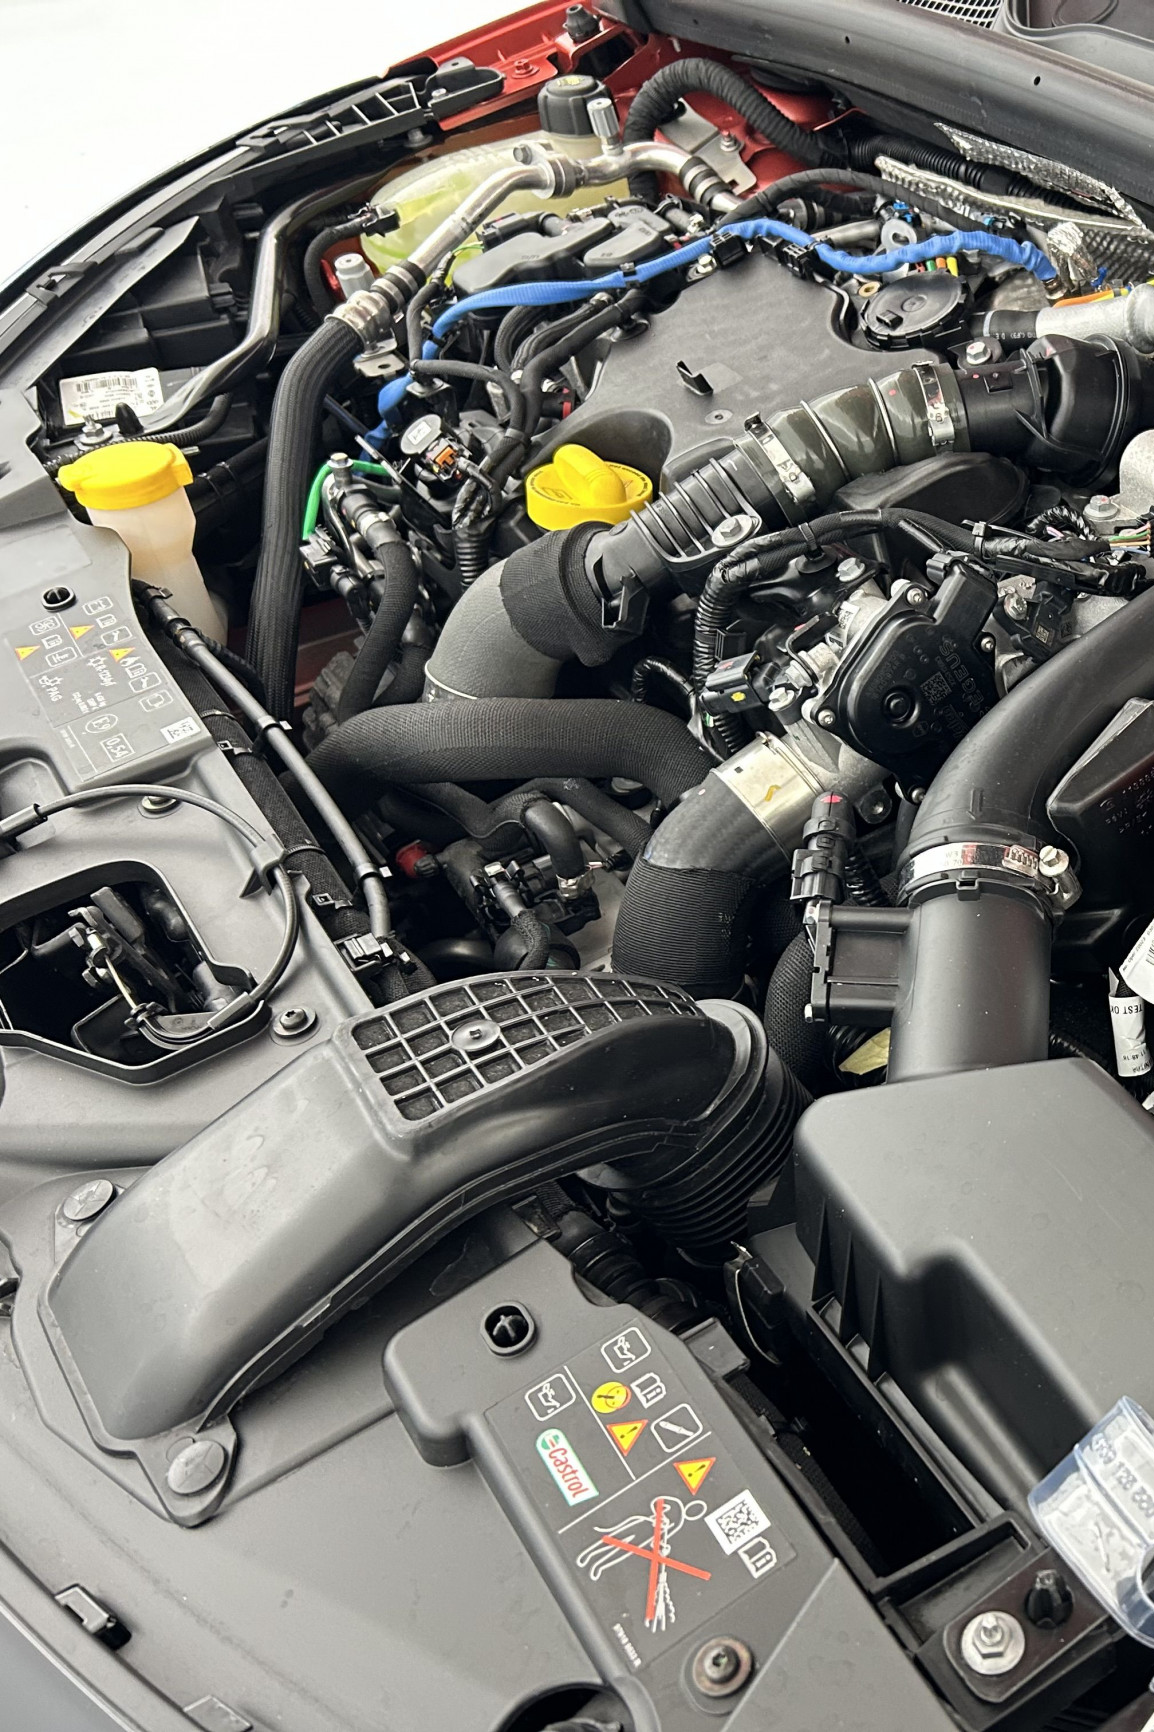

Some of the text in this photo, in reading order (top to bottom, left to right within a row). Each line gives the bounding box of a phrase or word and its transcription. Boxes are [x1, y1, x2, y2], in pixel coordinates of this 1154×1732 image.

[46, 687, 63, 702] PAG
[92, 716, 110, 730] E9
[105, 737, 129, 759] 0,54
[1122, 1003, 1144, 1015] TEST
[549, 1447, 589, 1498] Castrol
